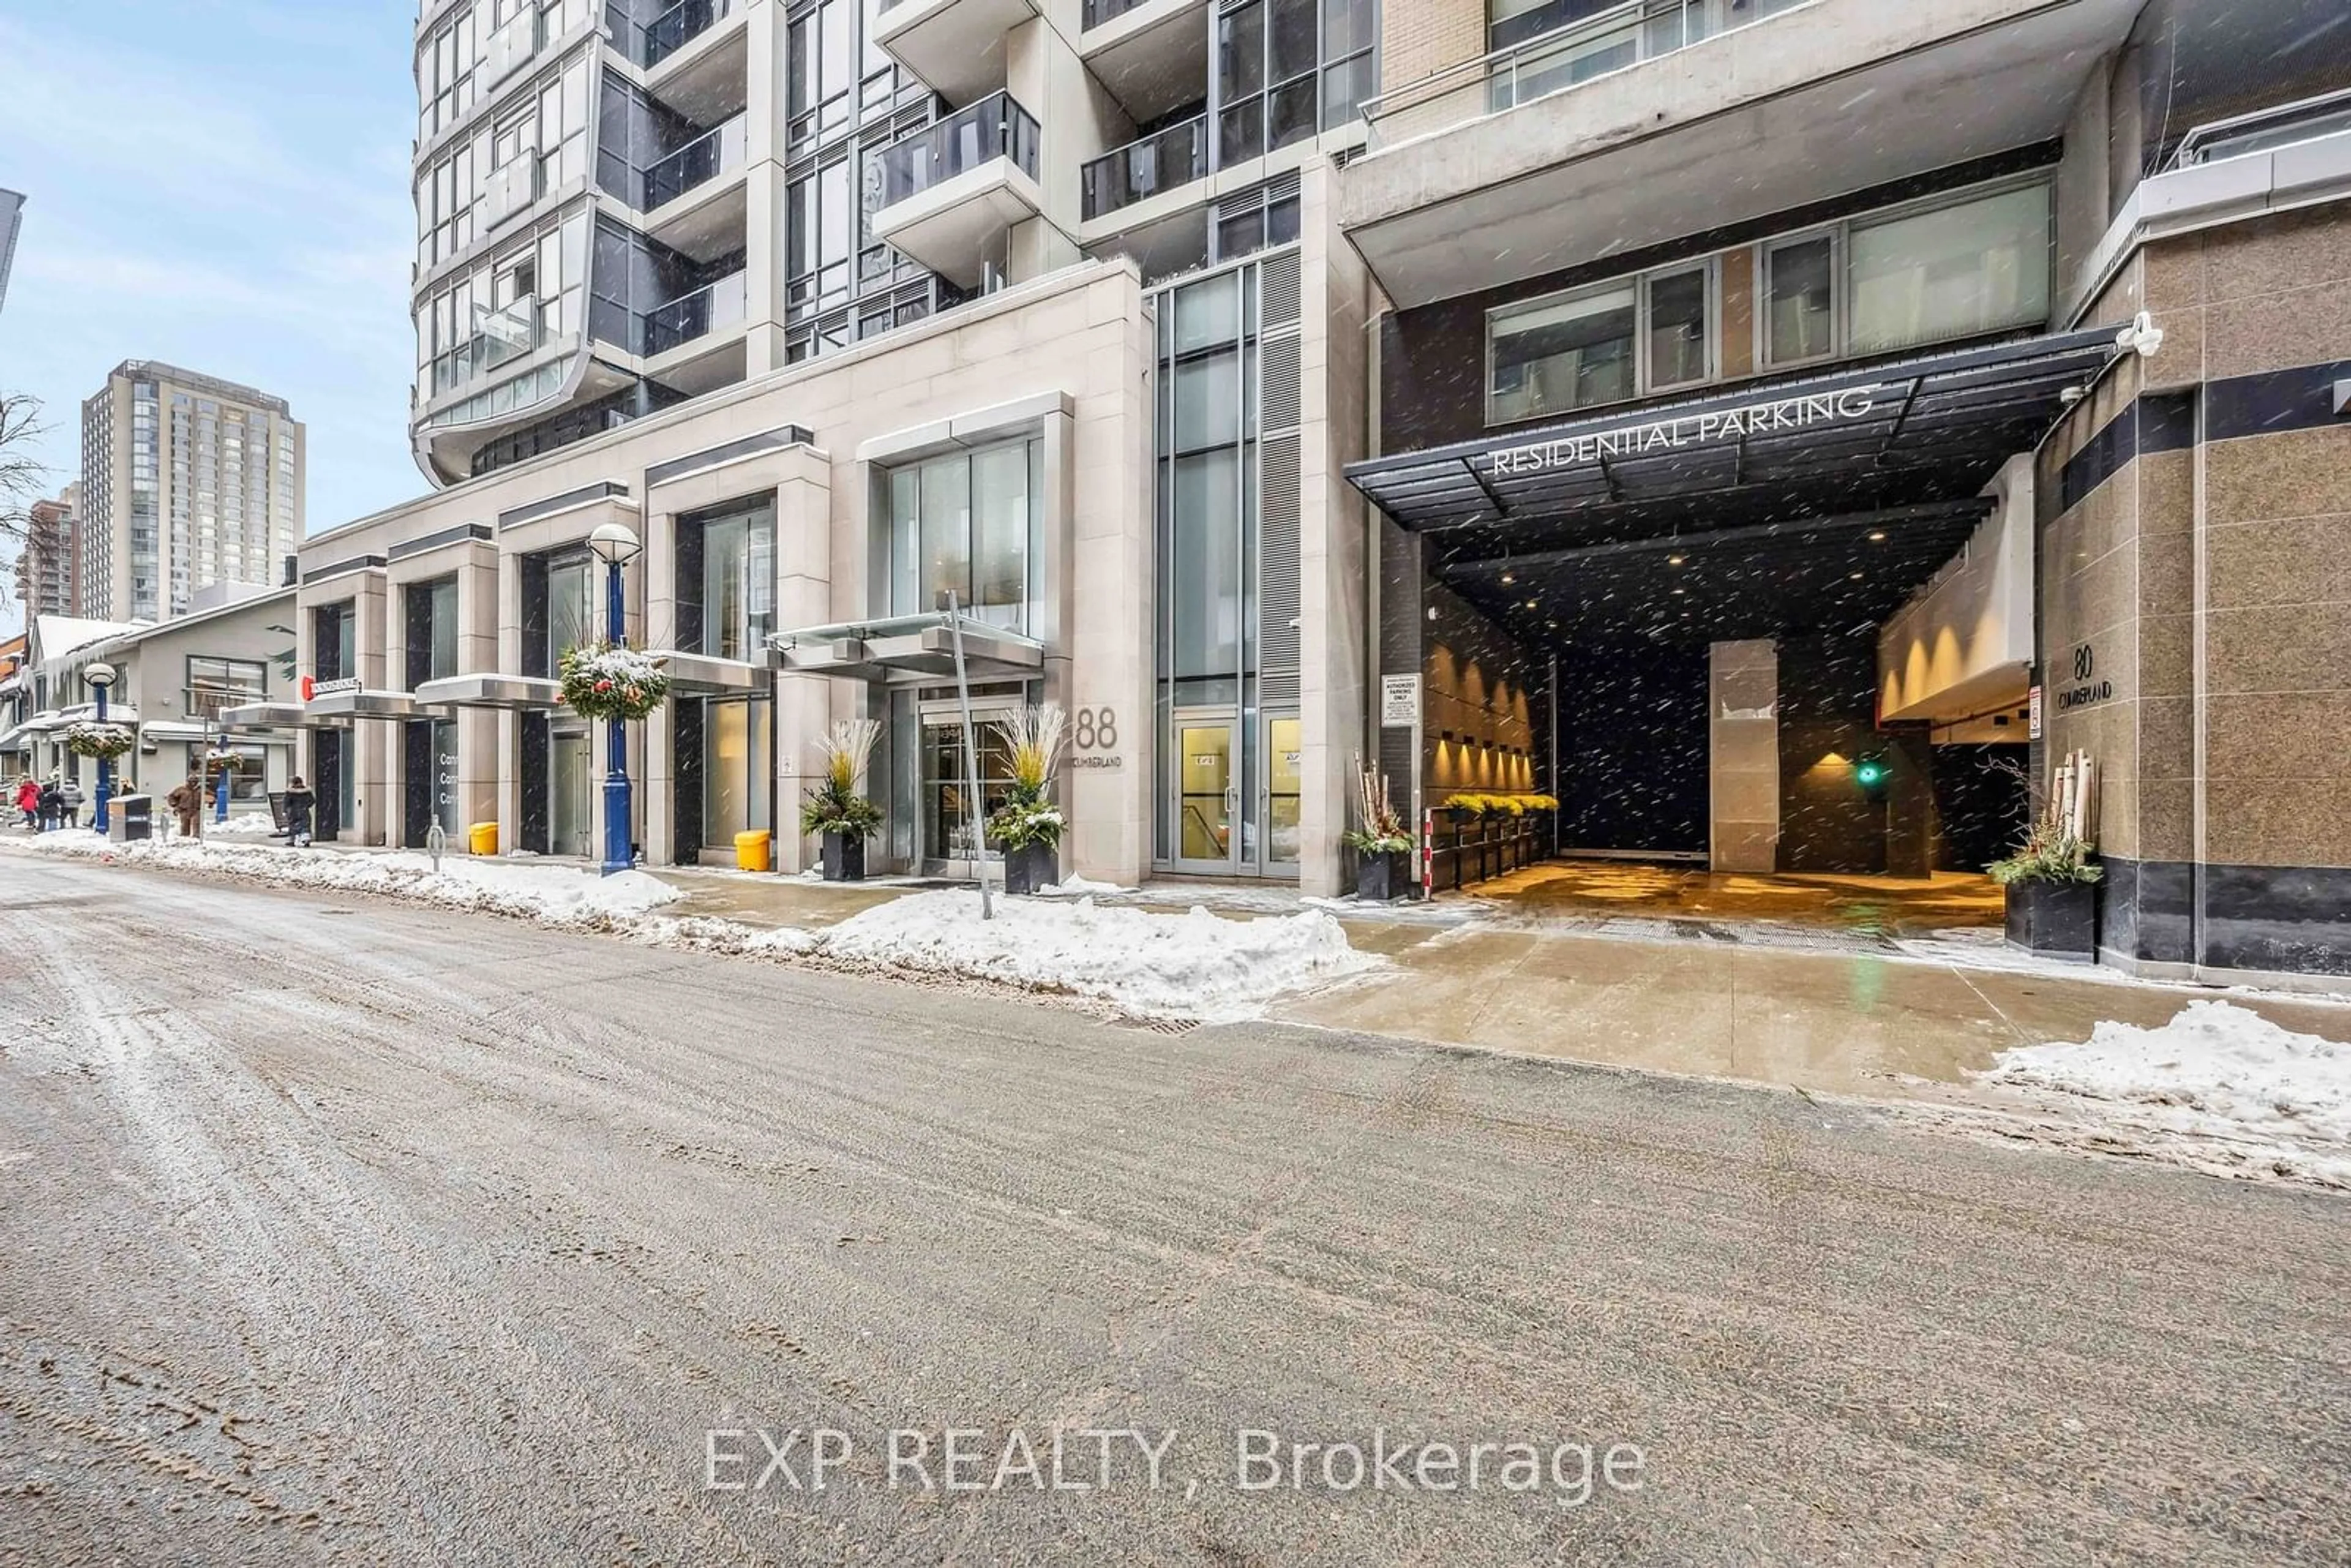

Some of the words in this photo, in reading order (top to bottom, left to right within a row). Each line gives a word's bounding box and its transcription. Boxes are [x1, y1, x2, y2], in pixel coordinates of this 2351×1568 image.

[1493, 422, 1688, 476] RESIDENTIAL
[1700, 388, 1873, 442] PARKING
[2075, 645, 2093, 680] 80
[2058, 681, 2112, 709] CUMBERLAND
[1076, 707, 1118, 749] 88
[1071, 756, 1122, 768] CUMBERLAND
